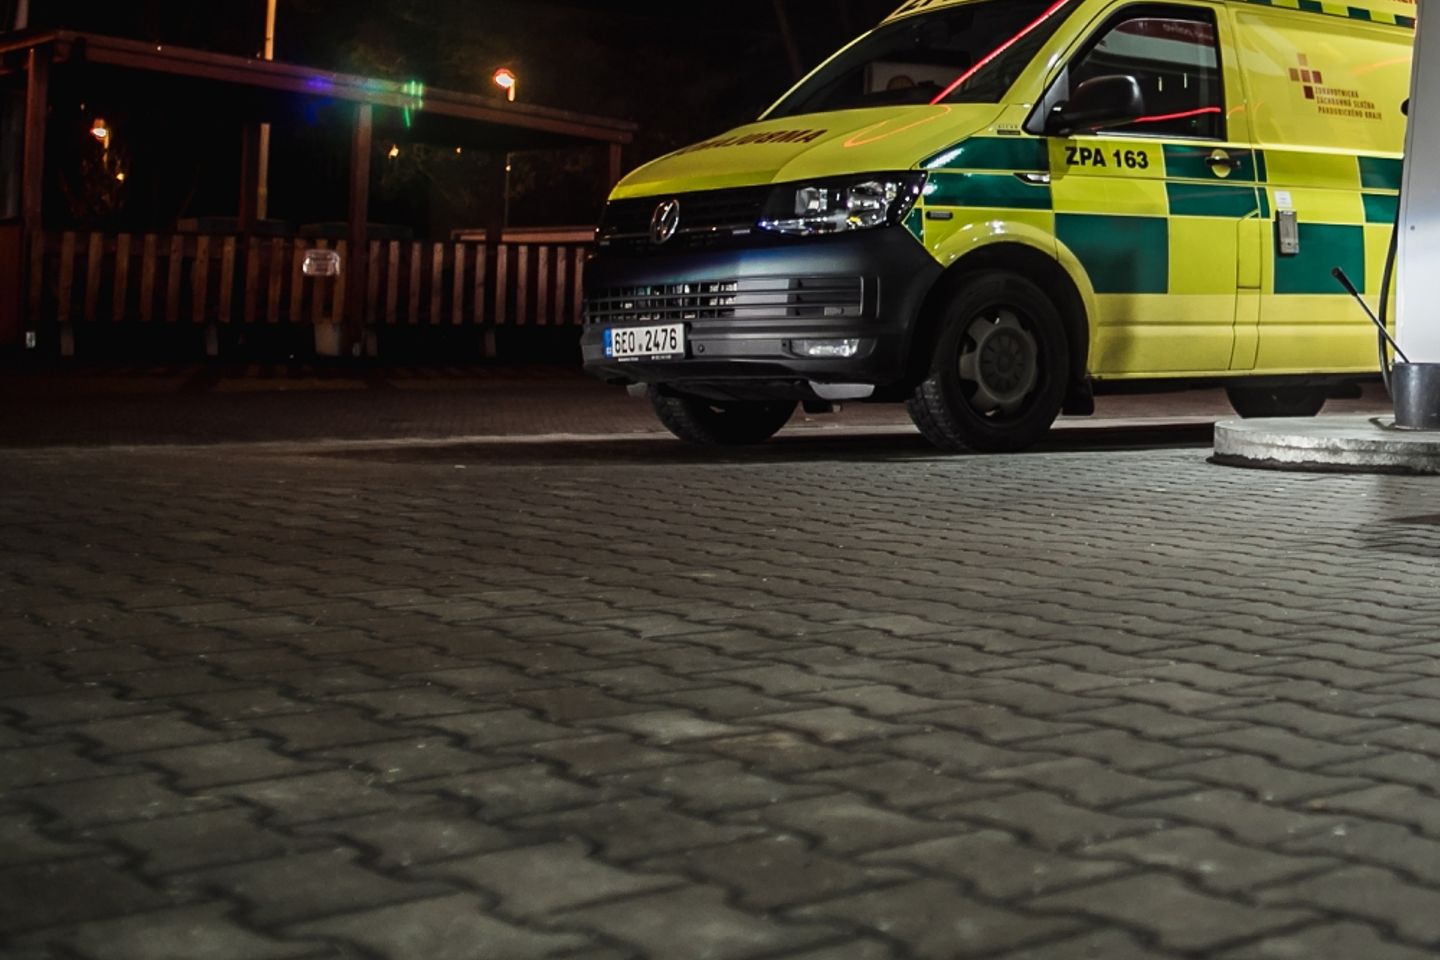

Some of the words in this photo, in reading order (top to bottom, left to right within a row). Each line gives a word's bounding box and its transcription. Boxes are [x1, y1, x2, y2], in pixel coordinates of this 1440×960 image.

[1065, 146, 1107, 167] ZPA
[1112, 149, 1149, 169] 163
[645, 328, 677, 352] 2476
